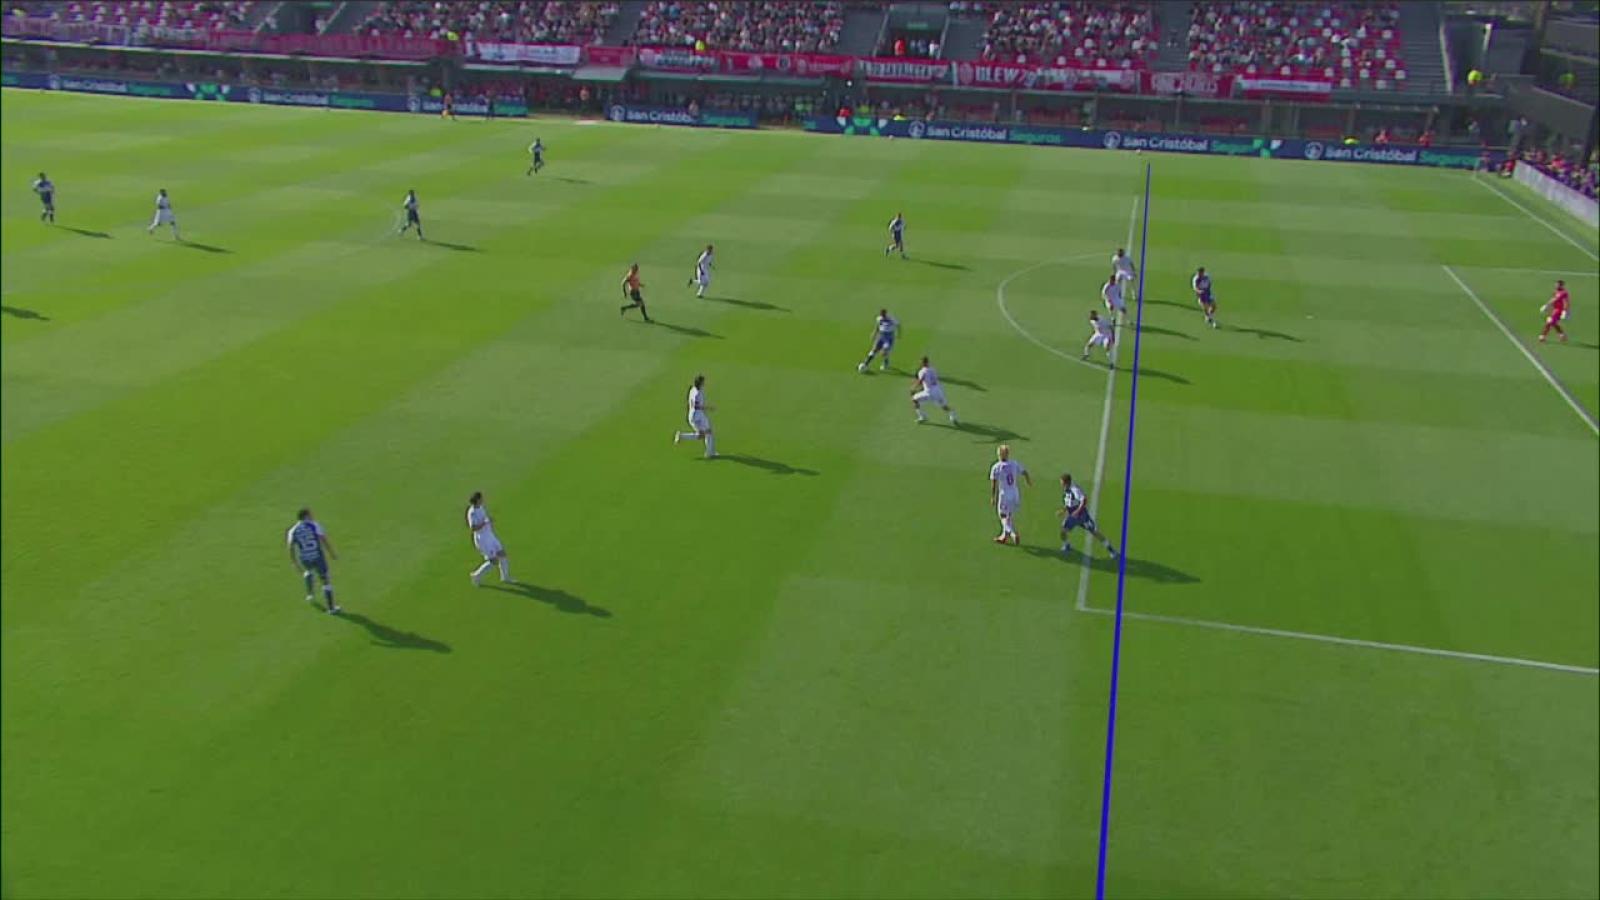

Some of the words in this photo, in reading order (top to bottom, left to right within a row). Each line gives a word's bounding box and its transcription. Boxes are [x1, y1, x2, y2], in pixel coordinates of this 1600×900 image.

[926, 126, 950, 137] San
[951, 127, 1006, 140] Cristóbal
[1123, 137, 1147, 148] San
[1149, 138, 1208, 151] Cristóbal
[1325, 146, 1351, 158] San
[1353, 147, 1417, 161] Cristóbal
